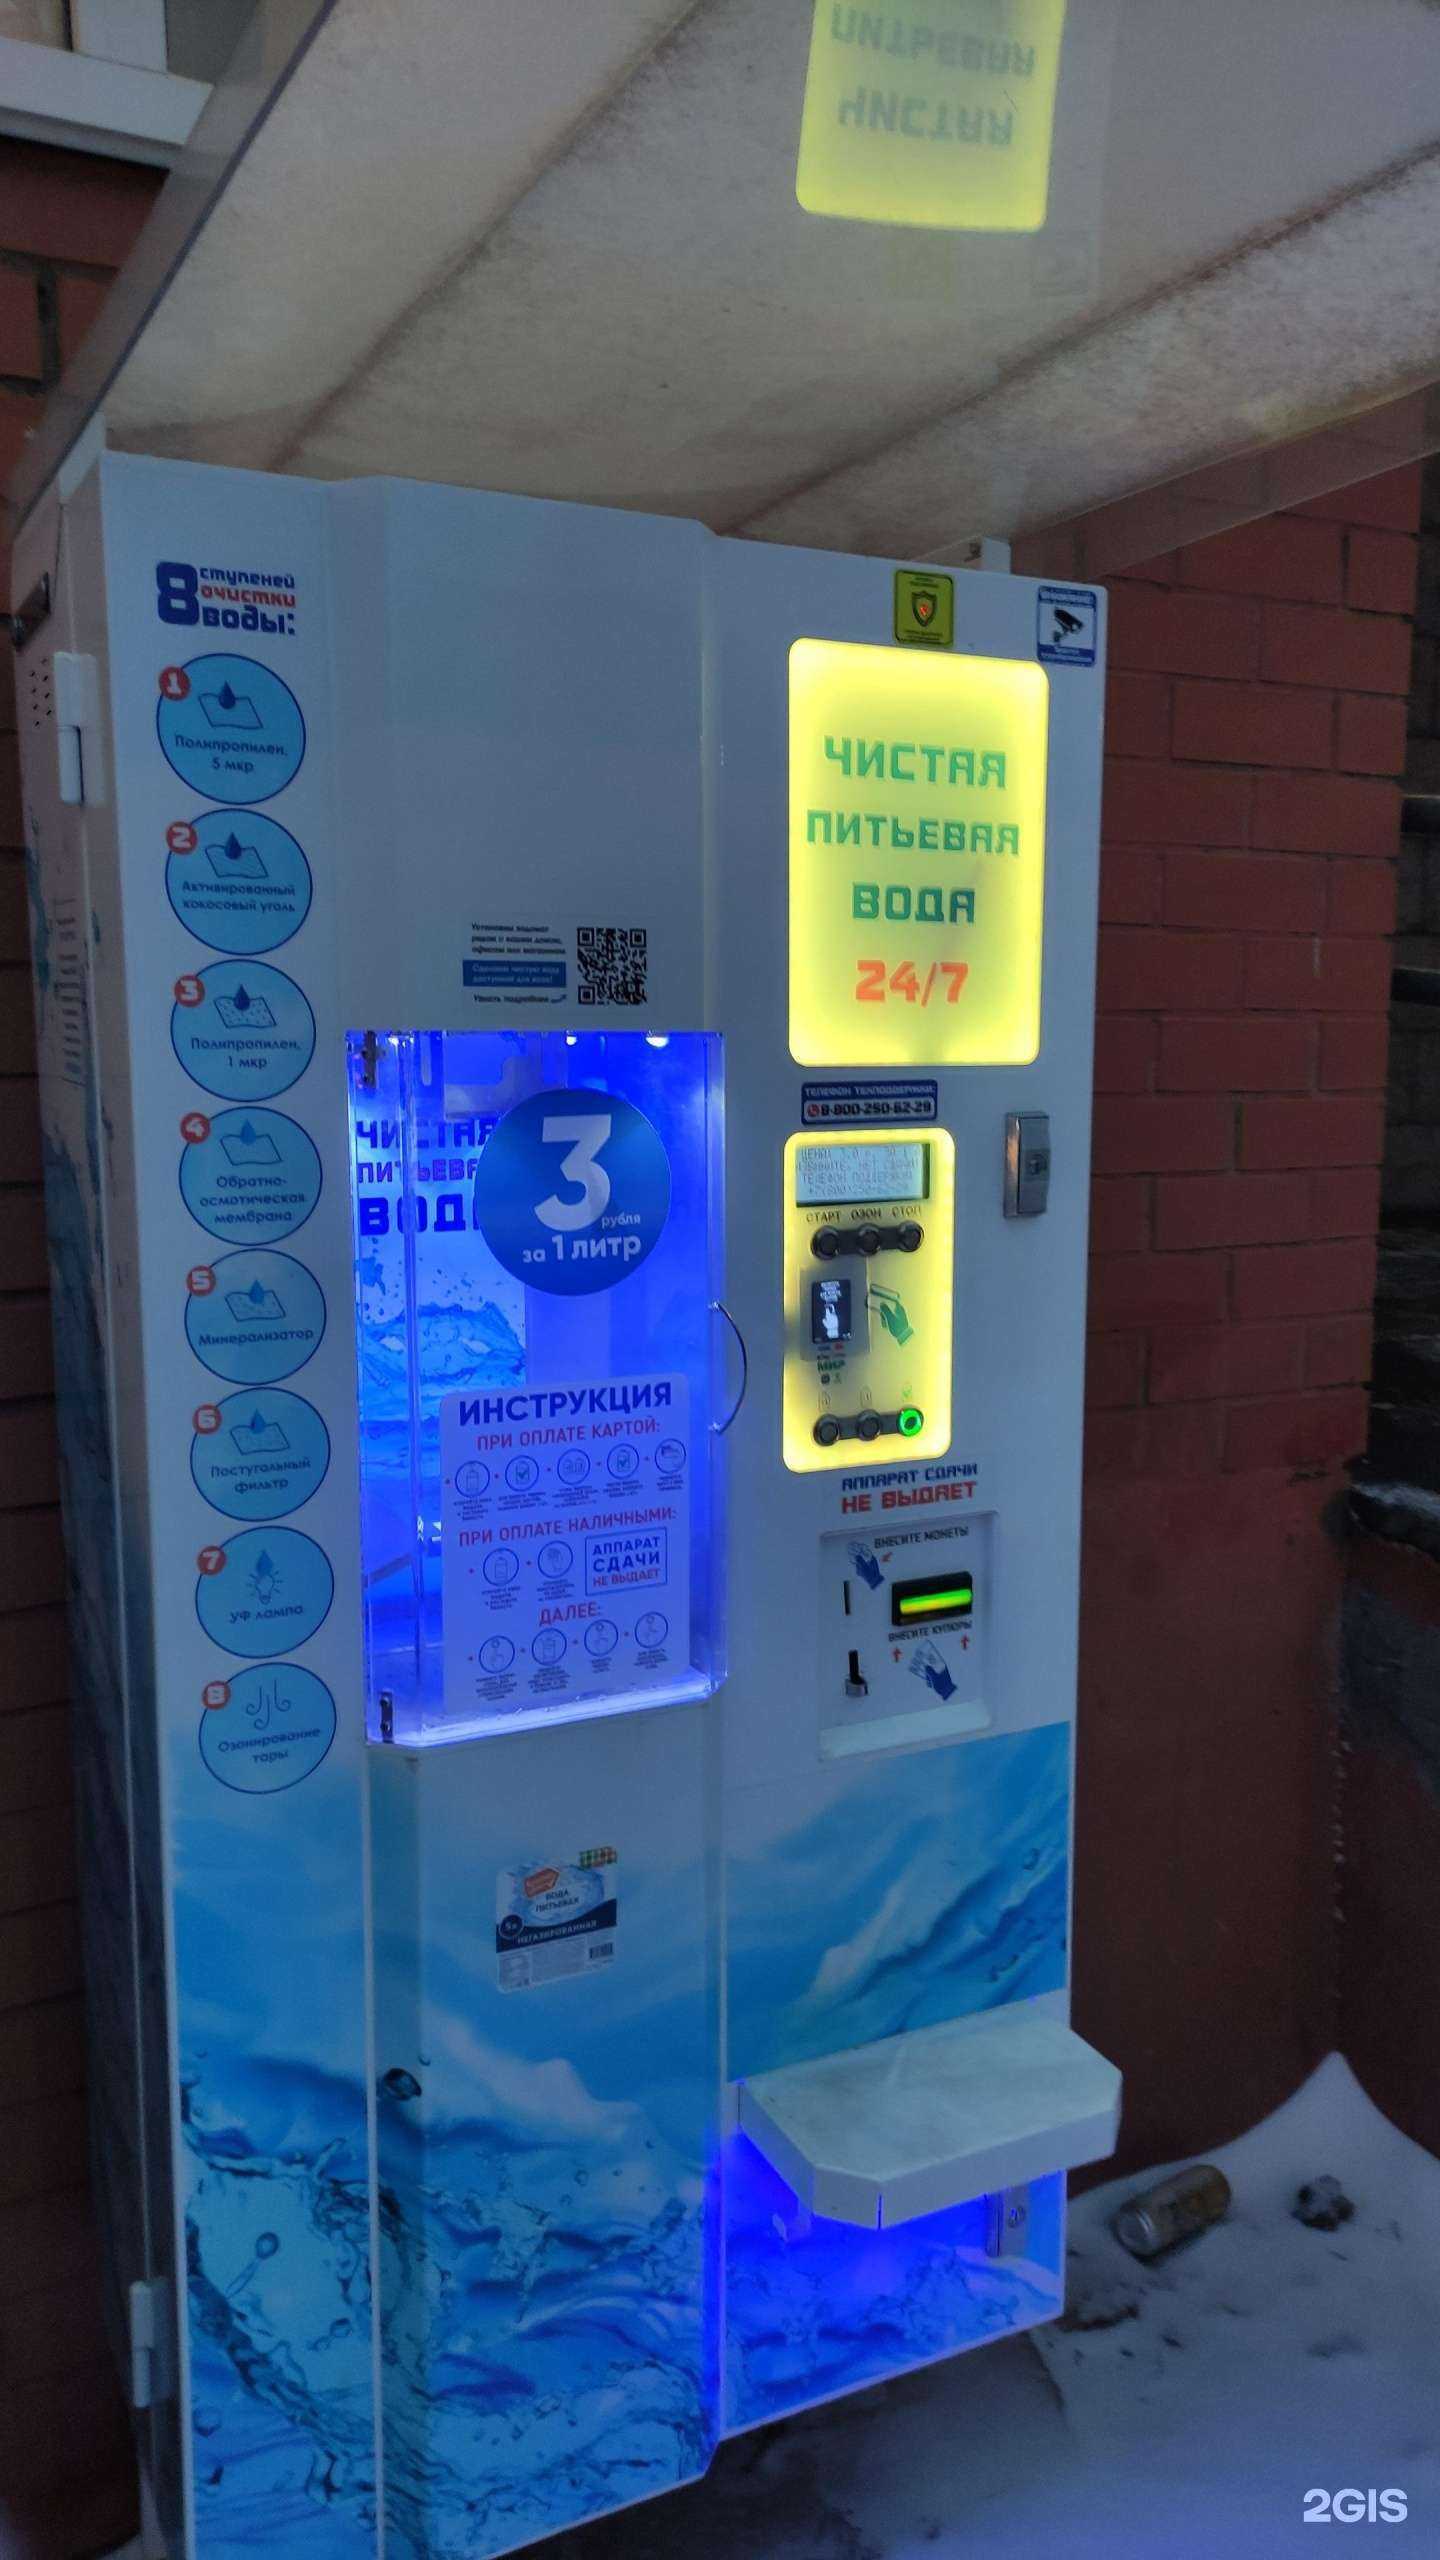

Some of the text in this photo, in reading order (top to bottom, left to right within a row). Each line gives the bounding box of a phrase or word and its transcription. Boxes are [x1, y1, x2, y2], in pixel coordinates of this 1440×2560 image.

[199, 567, 295, 589] ступеней
[156, 561, 200, 626] 8
[200, 584, 296, 608] очистки
[202, 604, 296, 635] воды:
[167, 672, 182, 695] 1
[824, 735, 1008, 790] ЧИСТАЯ
[171, 826, 192, 848] 2
[806, 808, 1020, 857] ПИТЬЕВАЯ
[182, 880, 296, 897] Активированный
[183, 899, 257, 912] кокосовый
[851, 881, 977, 925] ВОДА
[180, 979, 199, 1001] 3
[855, 959, 969, 1008] 24/7
[239, 1057, 267, 1070] мкр
[216, 1175, 287, 1189] Обратно-
[533, 1113, 612, 1232] 3
[214, 1210, 292, 1224] мембрана
[359, 1194, 479, 1236] ВОД
[601, 1212, 641, 1230] рубля
[806, 1205, 921, 1222] СТАРТ ОЗОН СТОП
[522, 1233, 642, 1264] за 1 литр
[191, 1269, 212, 1291] 5
[199, 1329, 314, 1347] Минерализатор
[459, 1382, 672, 1427] ИНСТРУКЦИЯ
[477, 1415, 661, 1451] ПРИ ОПЛАТЕ КАРТОЙ:
[234, 1478, 289, 1495] фильтр
[842, 1463, 978, 1491] АППАРАТ СДАЧИ
[841, 1481, 978, 1514] НЕ ВЫДАЕТ
[459, 1506, 677, 1547] ПРИ ОПЛАТЕ НАЛИЧНЫМИ:
[873, 1525, 968, 1549] ВНЕСИТЕ МОНЕТЫ
[592, 1535, 661, 1556] АППАРАТ
[202, 1550, 220, 1571] 7
[592, 1550, 661, 1573] СДАЧИ
[593, 1568, 660, 1588] НЕ ВЫДАЕТ
[538, 1601, 601, 1627] ДАЛЕЕ:
[888, 1627, 929, 1643] ВНЕСИТЕ
[217, 1728, 321, 1753] Озонирование
